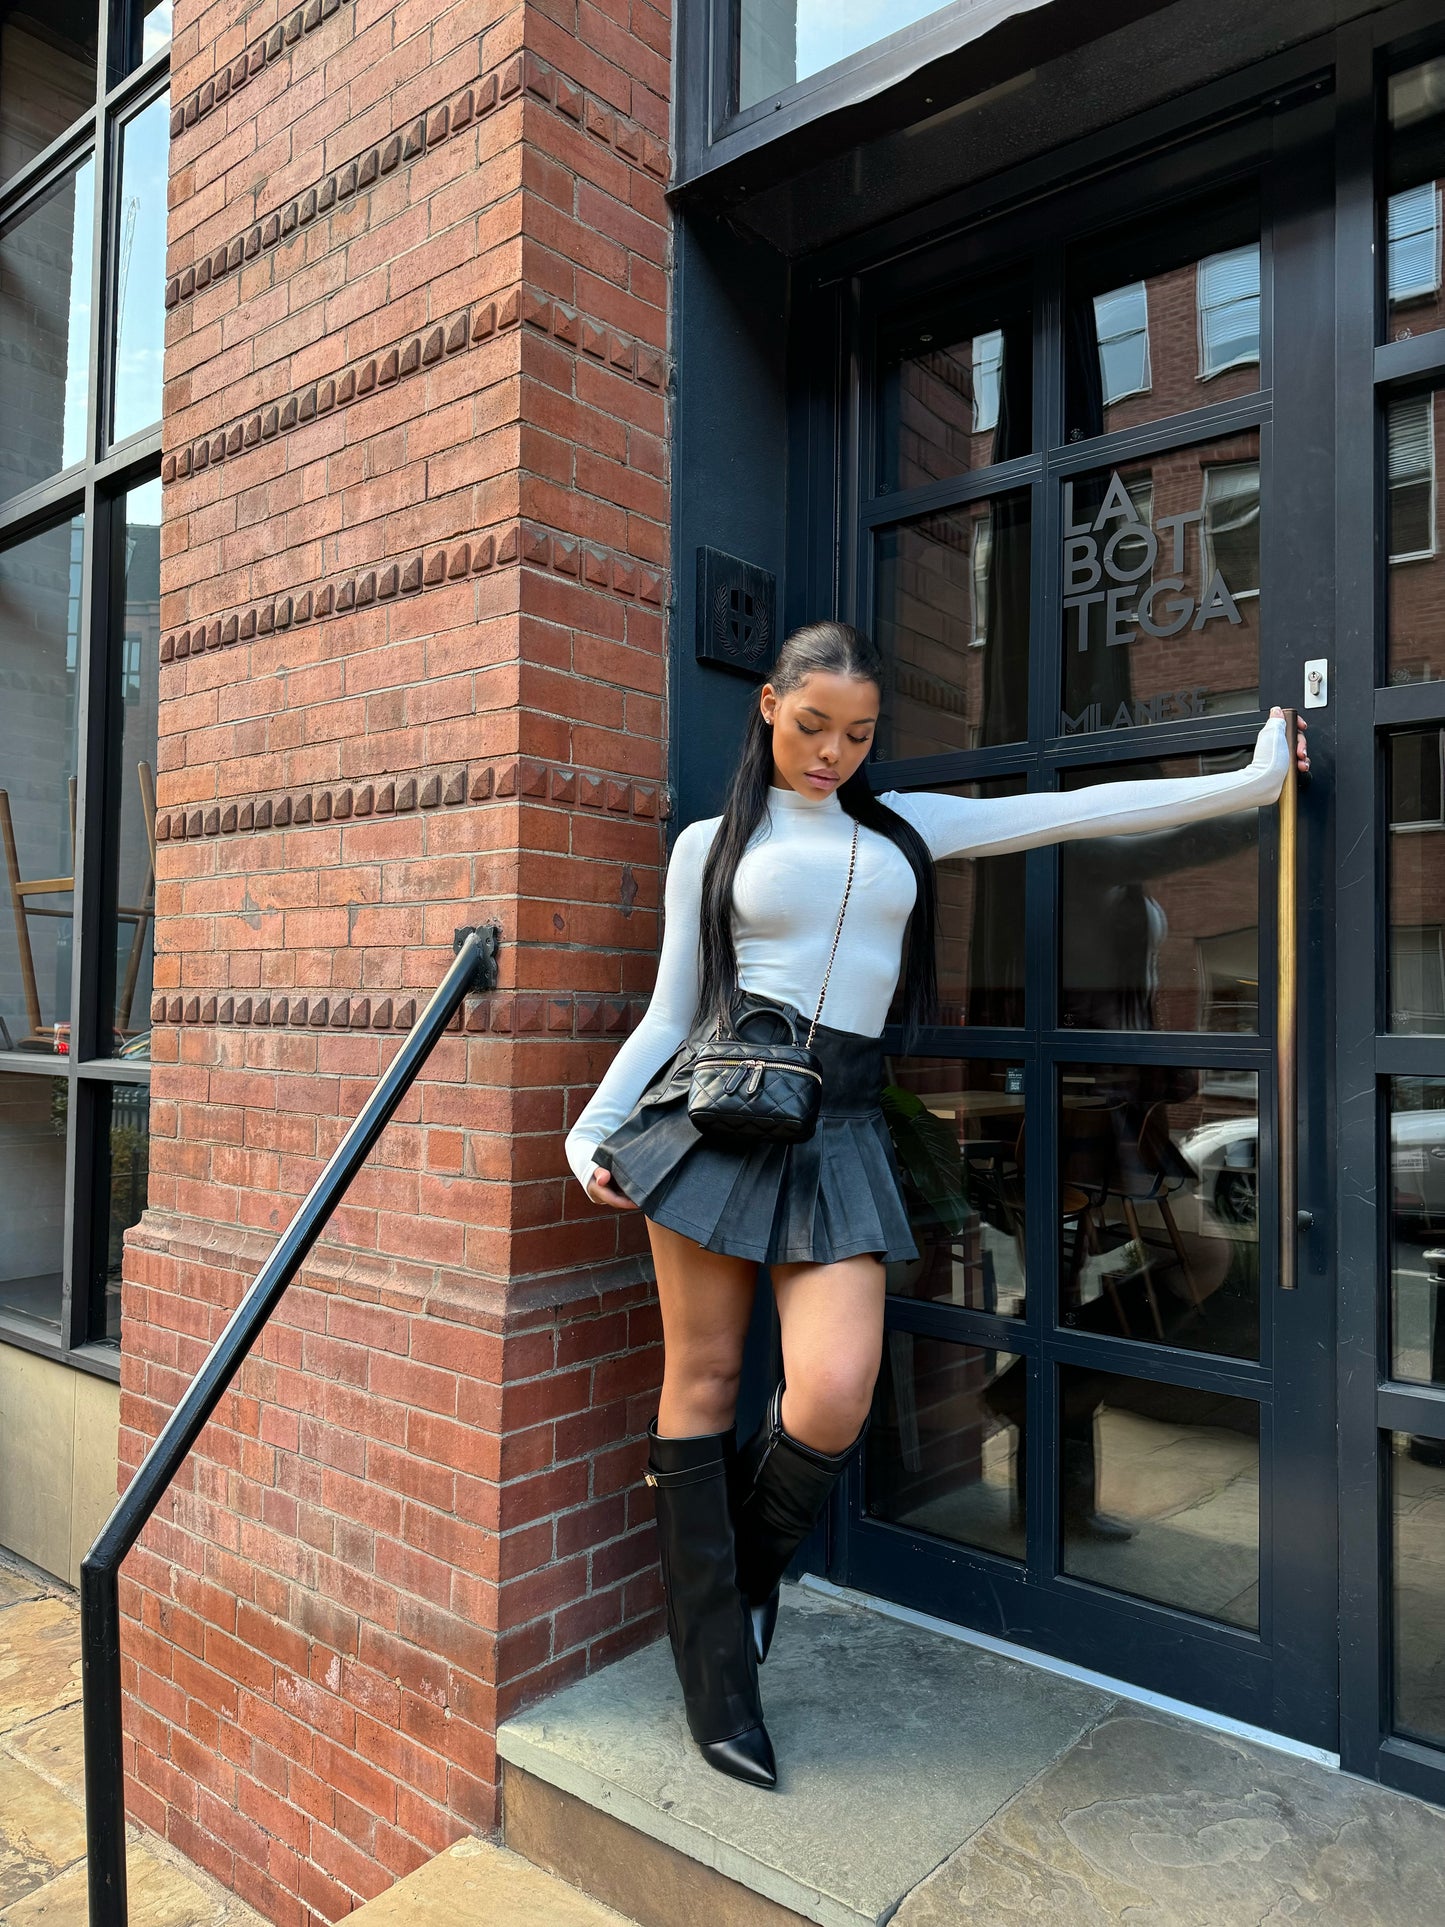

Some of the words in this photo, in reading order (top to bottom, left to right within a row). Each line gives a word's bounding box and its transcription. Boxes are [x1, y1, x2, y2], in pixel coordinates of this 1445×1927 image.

[1064, 470, 1139, 538] LA
[1064, 510, 1201, 596] BOT
[1064, 568, 1242, 652] TEGA
[1061, 687, 1208, 737] MILANESE
